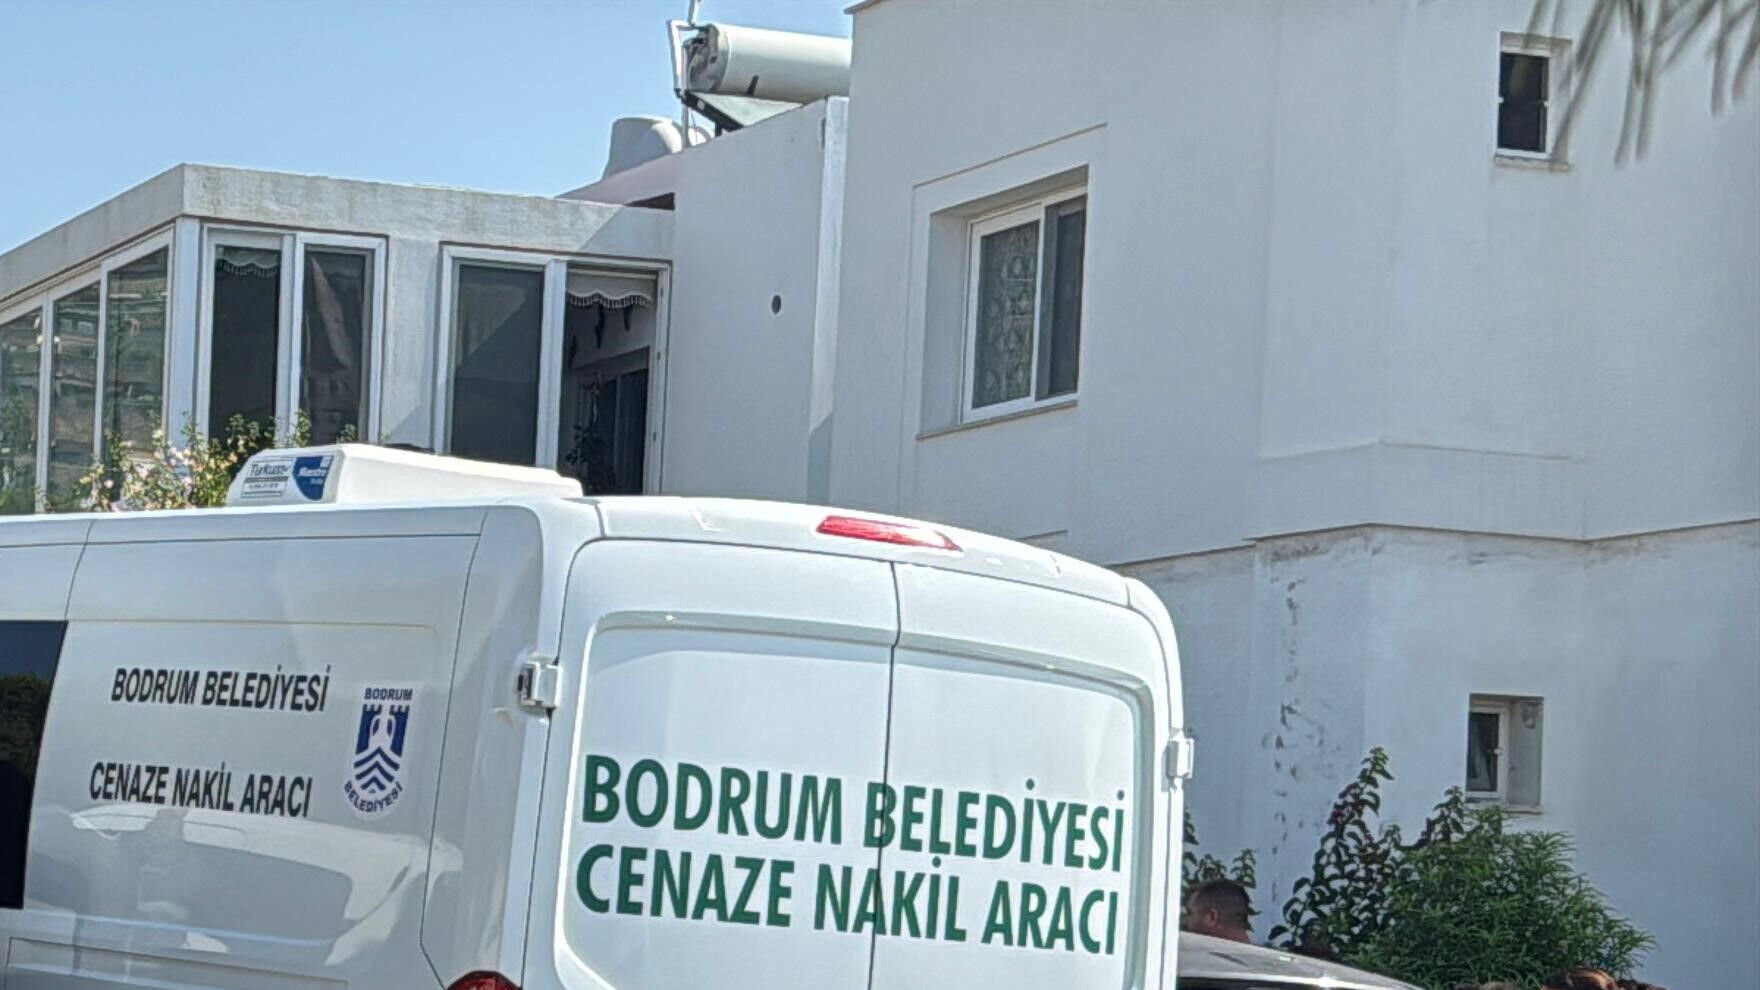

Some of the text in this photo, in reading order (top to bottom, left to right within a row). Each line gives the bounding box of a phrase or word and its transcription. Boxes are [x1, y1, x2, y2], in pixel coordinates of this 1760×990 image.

[111, 664, 331, 712] BODRUM BELEDİYESİ
[364, 687, 413, 701] BODRUM
[89, 761, 313, 818] CENAZE NAKİL ARACI
[344, 780, 403, 813] BELEDİYESİ
[582, 754, 1125, 873] BODRUM BELEDİYESİ
[576, 845, 1119, 955] CENAZE NAKİL ARACI
